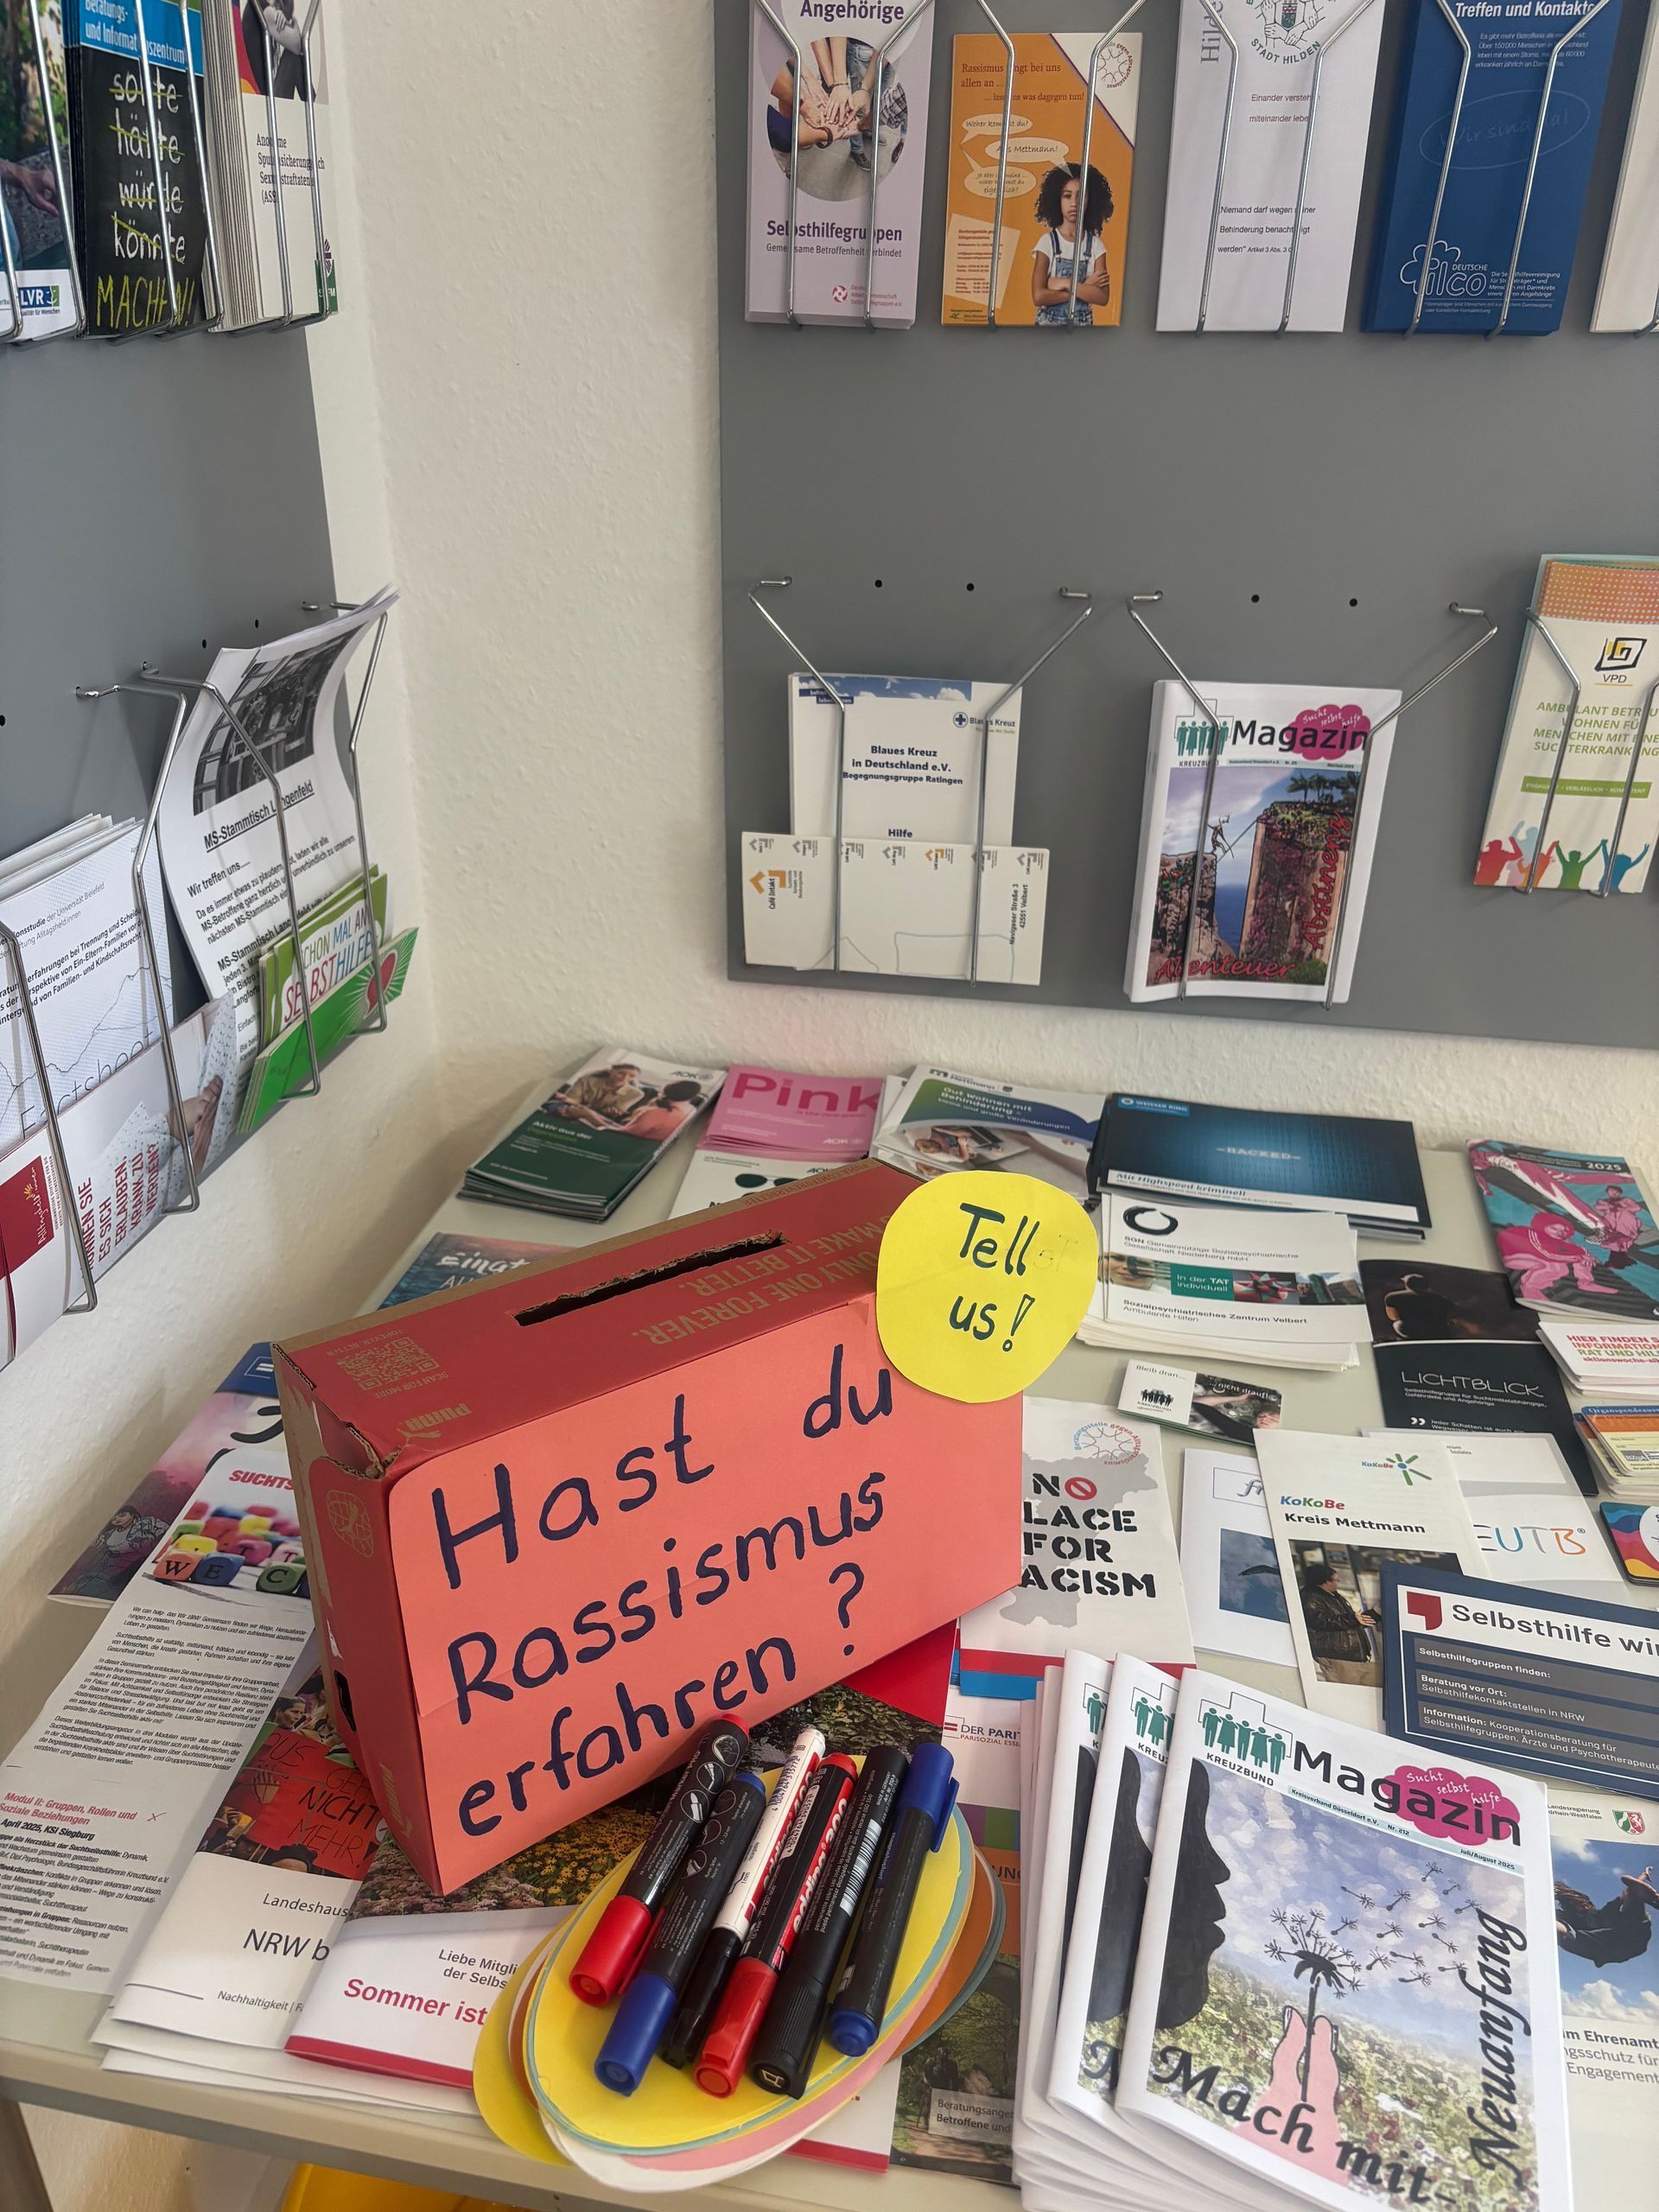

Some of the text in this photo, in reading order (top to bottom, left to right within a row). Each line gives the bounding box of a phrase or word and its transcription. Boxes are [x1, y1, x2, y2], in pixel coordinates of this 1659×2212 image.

[800, 0, 905, 24] Angehörige
[1455, 3, 1501, 18] Treffen
[1505, 2, 1530, 16] und
[1251, 38, 1321, 64] STADT HILDEN
[962, 63, 1003, 73] Rassismus
[1030, 63, 1043, 73] bei
[113, 67, 179, 113] solte
[961, 79, 982, 87] allen
[1038, 93, 1067, 103] dagegen
[1251, 93, 1283, 102] Einander
[1249, 114, 1292, 123] miteinander
[1253, 206, 1268, 214] darf
[766, 219, 902, 244] Selsthilfegrupen
[1219, 226, 1264, 234] Behinderung
[816, 245, 865, 257] Betroffenheit
[20, 289, 44, 305] LVR
[1601, 673, 1628, 683] VPD
[1536, 701, 1610, 716] AMBLANT
[1231, 720, 1370, 753] Magazin
[1533, 728, 1630, 743] MENCHEN MIT
[870, 746, 938, 757] Blaues Kreuz
[851, 759, 951, 772] in Deutschland e.V.
[842, 772, 963, 785] Begegnungsgruppe Ratingen
[204, 779, 314, 850] MS-Stammtisch Lngenfeld
[887, 829, 913, 838] Hilfe
[187, 869, 227, 898] Wir treffen
[767, 878, 776, 897] Intakt
[80, 927, 108, 952] Trennung
[218, 929, 275, 971] MS-Stammtisch
[302, 922, 352, 969] CHON MAL
[732, 1073, 880, 1112] Pink
[1586, 1160, 1623, 1172] 2025
[78, 1177, 93, 1210] SIE
[98, 1197, 111, 1262] ES SICH
[959, 1203, 1040, 1276] Tell
[678, 1222, 884, 1296] MAKE BETTER.
[1176, 1281, 1230, 1293] individuell
[1187, 1275, 1230, 1286] der TAT
[631, 1273, 823, 1345] ONE FOREVER.
[1229, 1313, 1308, 1325] Zentrum Velbert
[949, 1294, 1036, 1352] us!
[1400, 1370, 1544, 1398] LICHTBLICK
[404, 1402, 472, 1432] PUMA
[431, 1343, 893, 1590] Hast du
[1361, 1459, 1395, 1471] KoKoBe
[1279, 1494, 1346, 1512] KoKoBe
[1023, 1501, 1138, 1532] LACE
[1284, 1512, 1427, 1535] Kreis Mettmann
[1023, 1531, 1114, 1563] FOR
[1019, 1564, 1156, 1599] ACISM
[447, 1471, 887, 1726] Rassismus
[1452, 1604, 1611, 1648] Selbsthilfe
[1419, 1647, 1551, 1679] Selbsthilfegruppen finden:
[1421, 1674, 1507, 1698] Beratung vor Ort:
[1421, 1683, 1586, 1723] Selbsthilfekontaktstellen NRW
[458, 1636, 797, 1838] erfahren
[961, 1722, 985, 1738] DER
[1423, 1707, 1618, 1752] Information: Kooperationsberatung für
[1423, 1716, 1568, 1753] Selbsthilfegruppen, Ärzte und
[1205, 1751, 1275, 1788] KREUZBUND
[1406, 1770, 1445, 1783] Sucht
[1294, 1739, 1522, 1847] Magazin
[1435, 1781, 1470, 1796] selbst
[1470, 1790, 1501, 1805] hilfe
[3, 1791, 138, 1821] Modul Gruppen, Rollen und
[31, 1808, 91, 1825] Beziehungen
[298, 1786, 381, 1830] NICHT
[1291, 1788, 1366, 1821] Kreisverband Düsseldorf
[0, 1818, 96, 1840] April 2025, KSI Siegburg
[1459, 1848, 1516, 1872] Juli/August 2025
[262, 1893, 349, 1918] Landeshaus
[243, 1928, 330, 1961] NRW b
[437, 1948, 476, 1968] Liebe
[442, 1967, 467, 1981] der
[217, 1989, 289, 2012] Nachhaltigkeit
[343, 1978, 488, 2025] Sommer ist
[1457, 1904, 1533, 2193] Neuanfang
[1154, 2044, 1314, 2154] Mach
[936, 2113, 990, 2132] Betroffene
